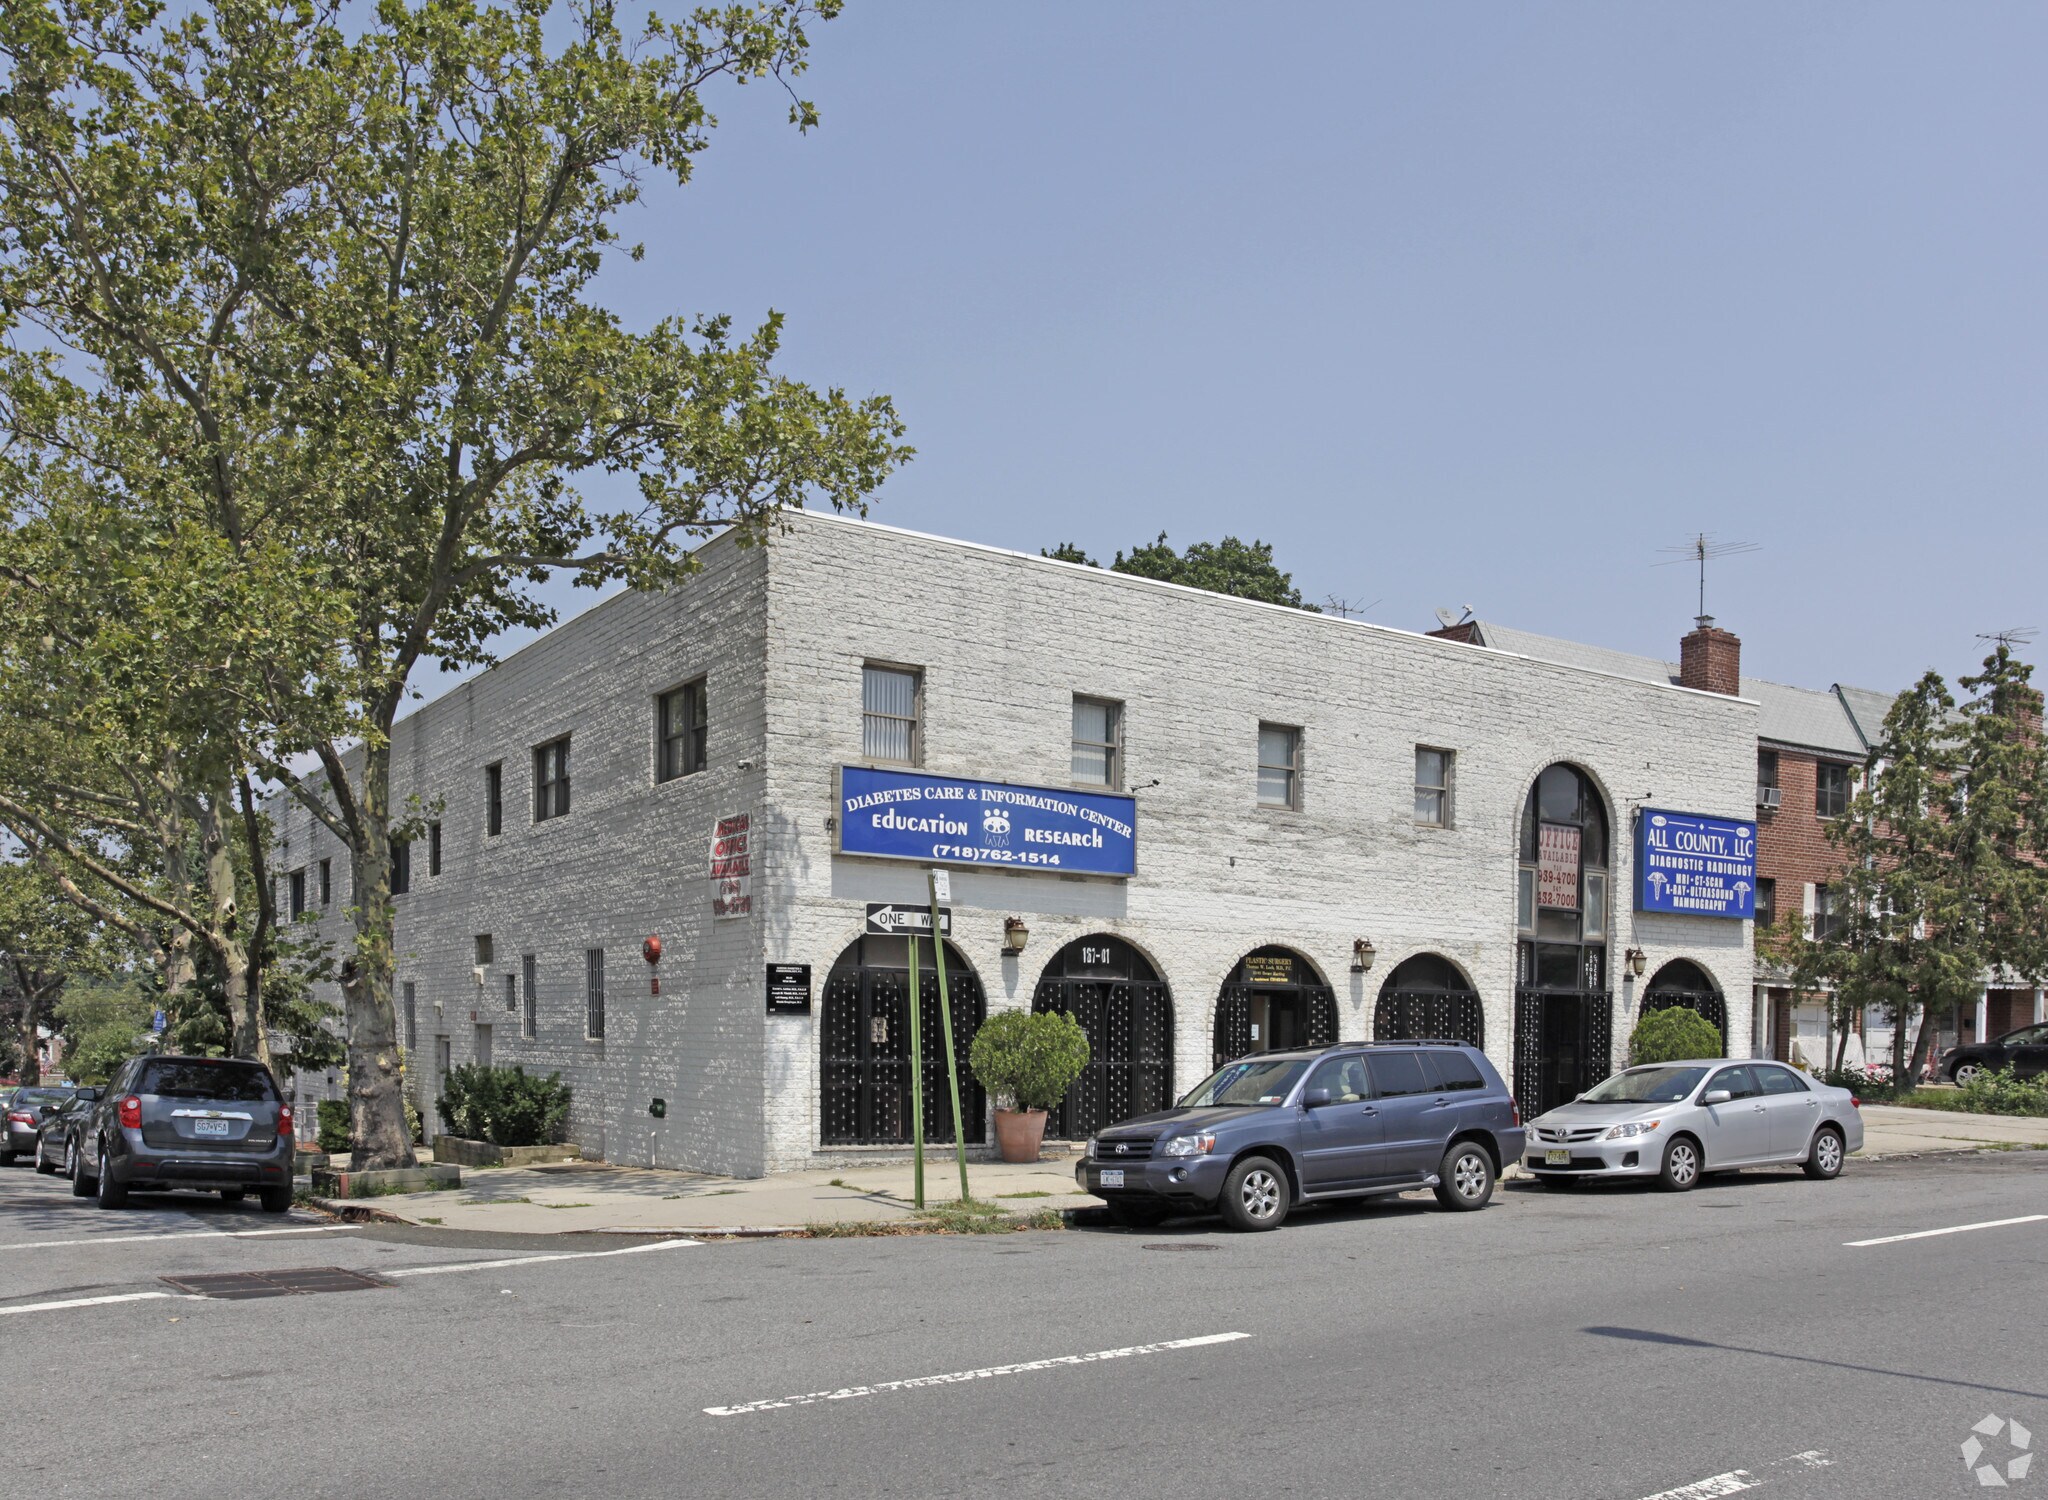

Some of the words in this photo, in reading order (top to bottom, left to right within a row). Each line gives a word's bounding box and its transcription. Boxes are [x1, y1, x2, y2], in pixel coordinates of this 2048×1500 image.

[846, 787, 922, 812] DIABETES
[923, 787, 964, 800] CARE
[967, 788, 978, 800] &
[981, 789, 1078, 816] INFORMATION
[1079, 808, 1132, 839] CENTER
[1539, 825, 1579, 850] OFFICE
[1647, 828, 1669, 848] ALL
[1675, 831, 1727, 857] COUNTY,
[1734, 838, 1753, 858] LLC
[932, 844, 1060, 865] (718)762-1514
[1649, 854, 1703, 871] DIAGNOSTIC
[1707, 861, 1752, 877] RADIOLOGY
[1675, 873, 1690, 885] MRI
[1694, 875, 1723, 888] CT-SCAN
[1665, 883, 1687, 896] X-RAY
[1690, 886, 1734, 900] ULTRASOUND
[1673, 896, 1727, 911] MAMMOGRAPHY
[879, 913, 905, 925] ONE
[1268, 957, 1292, 965] SURGERY
[196, 1122, 210, 1131] SG7
[214, 1123, 227, 1131] V5A
